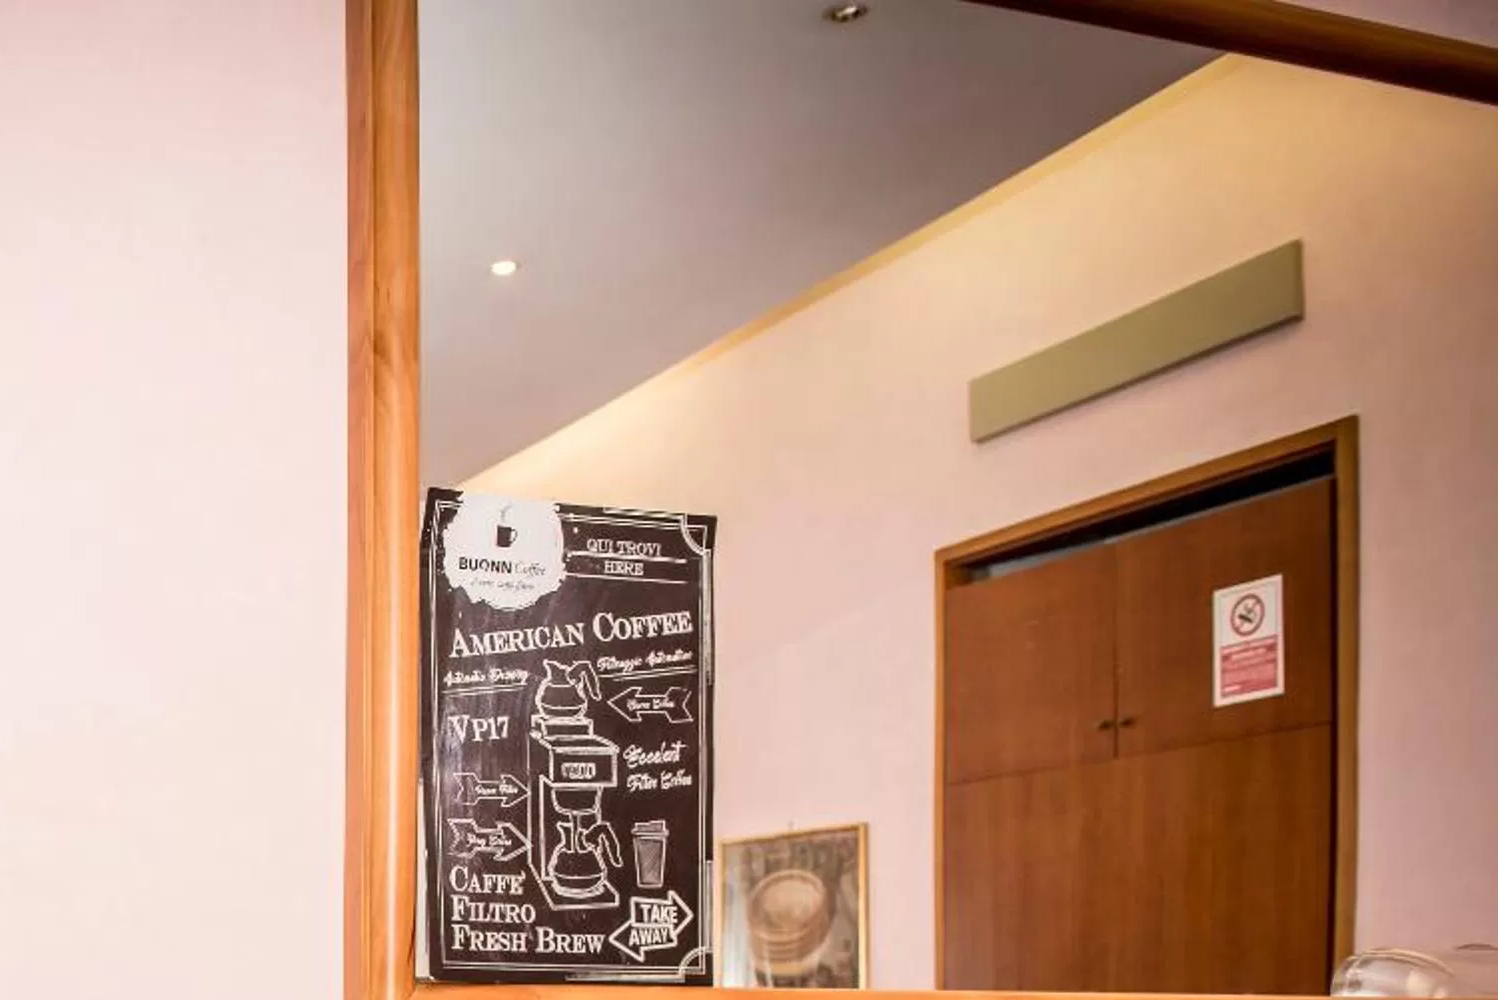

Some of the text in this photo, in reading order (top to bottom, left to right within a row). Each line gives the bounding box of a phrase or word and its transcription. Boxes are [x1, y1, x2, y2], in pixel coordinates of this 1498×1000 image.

[587, 538, 662, 557] QUI TROVI
[458, 557, 512, 573] BUONN
[604, 560, 644, 576] HERE
[449, 610, 694, 658] AMERICAN COFFEE
[447, 714, 510, 744] VP17
[451, 895, 536, 924] FILTRO
[639, 903, 679, 925] TAKE
[451, 924, 607, 955] FRESH BREW
[629, 926, 670, 948] AWAY
